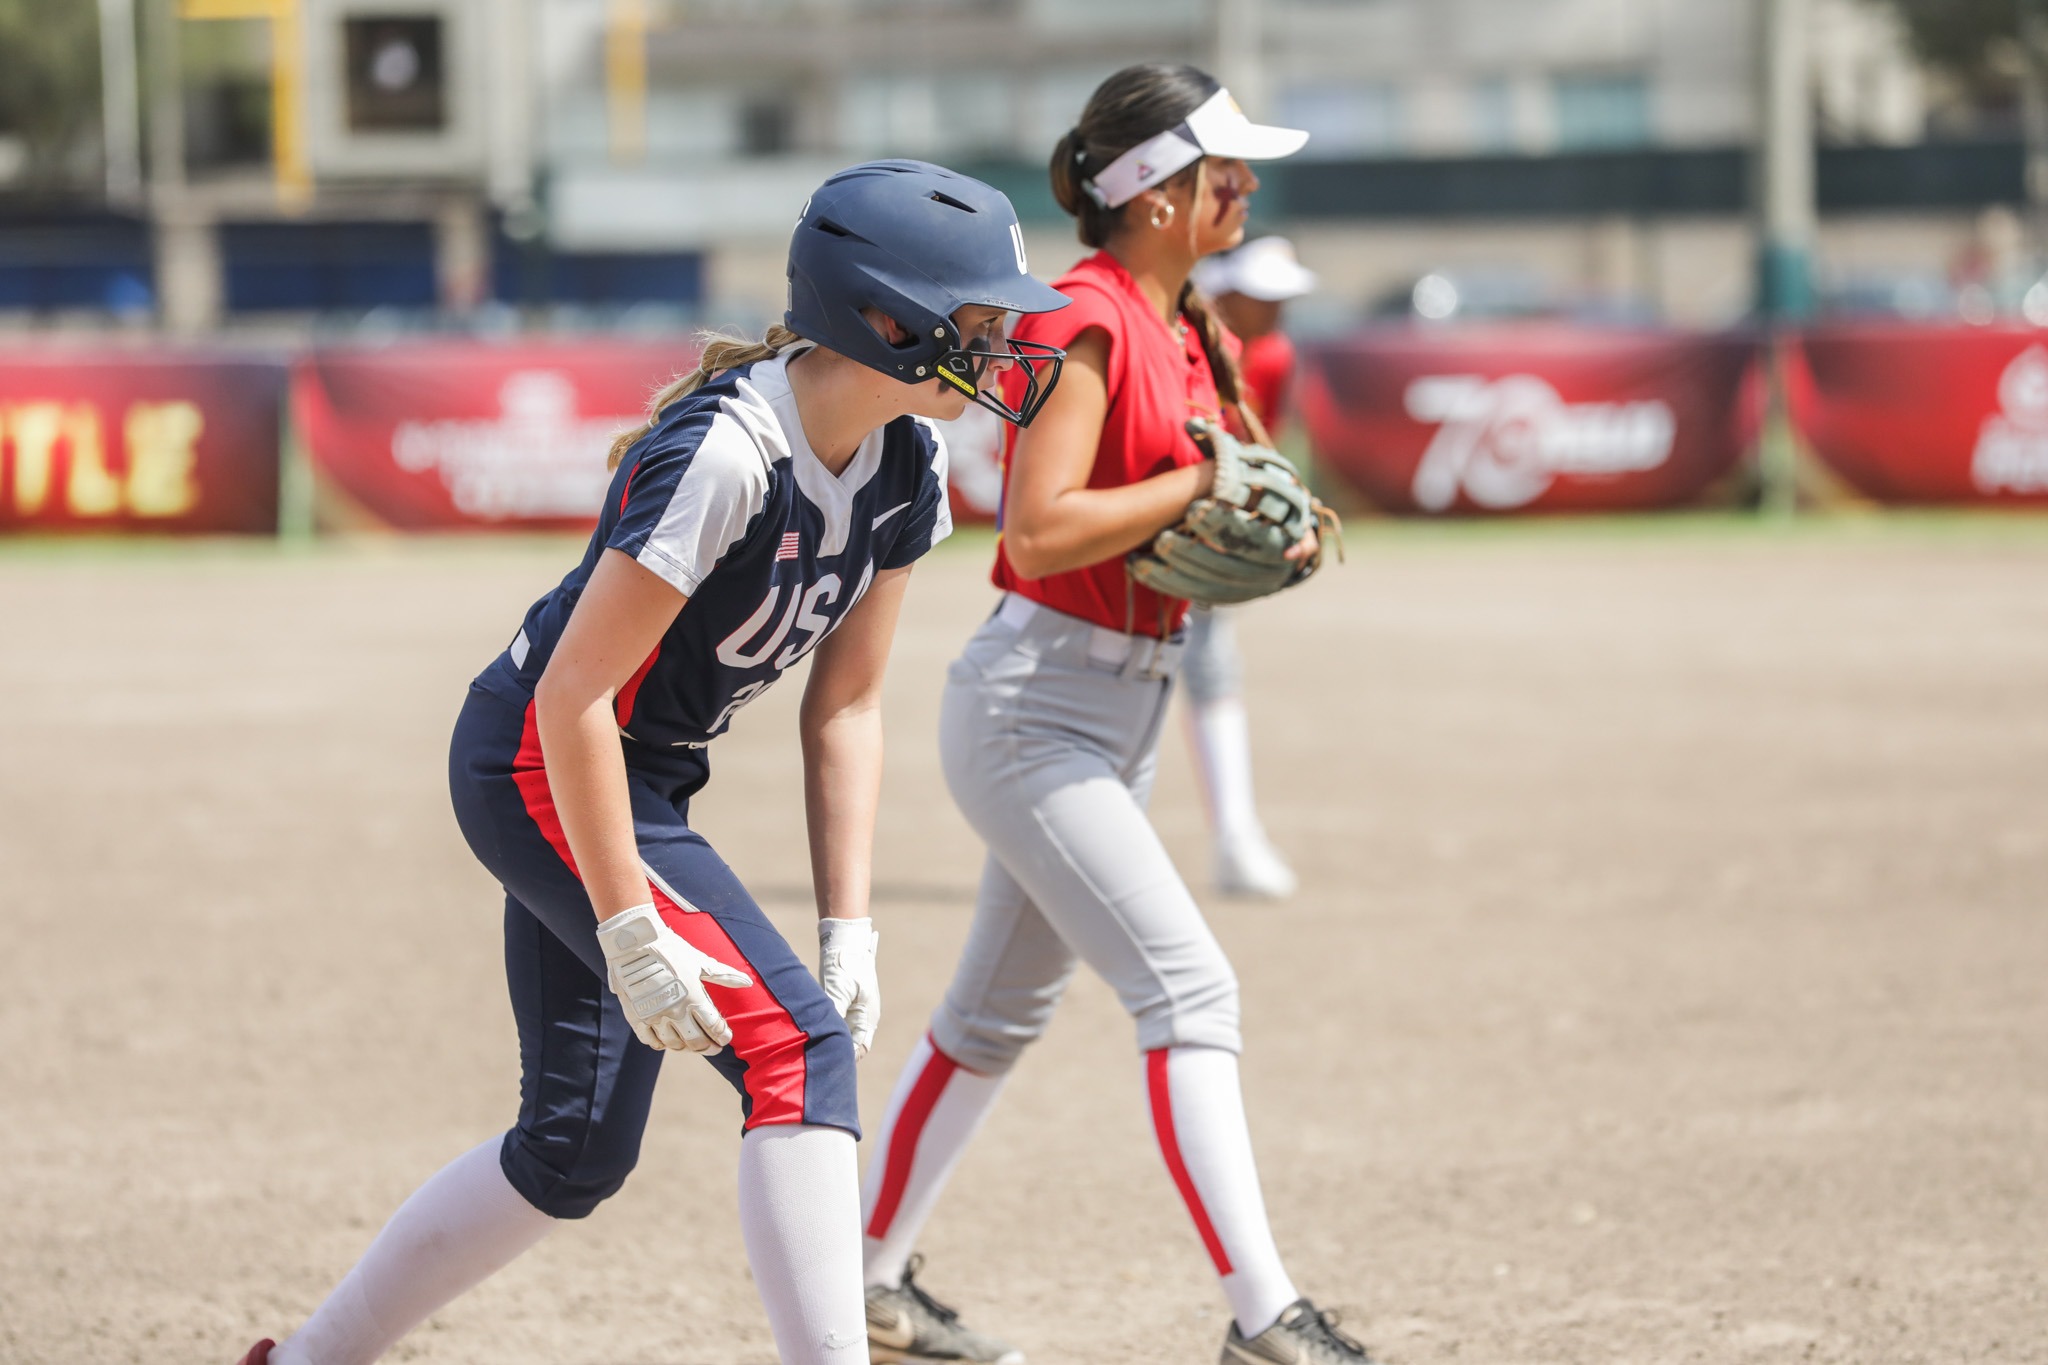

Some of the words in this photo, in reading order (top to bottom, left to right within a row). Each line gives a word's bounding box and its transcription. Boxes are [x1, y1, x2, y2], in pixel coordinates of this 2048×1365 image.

[986, 299, 1024, 309] EVOSHIELD
[940, 368, 973, 392] EVOSHIELD
[0, 402, 205, 517] TLE
[637, 982, 681, 1012] Franklin
